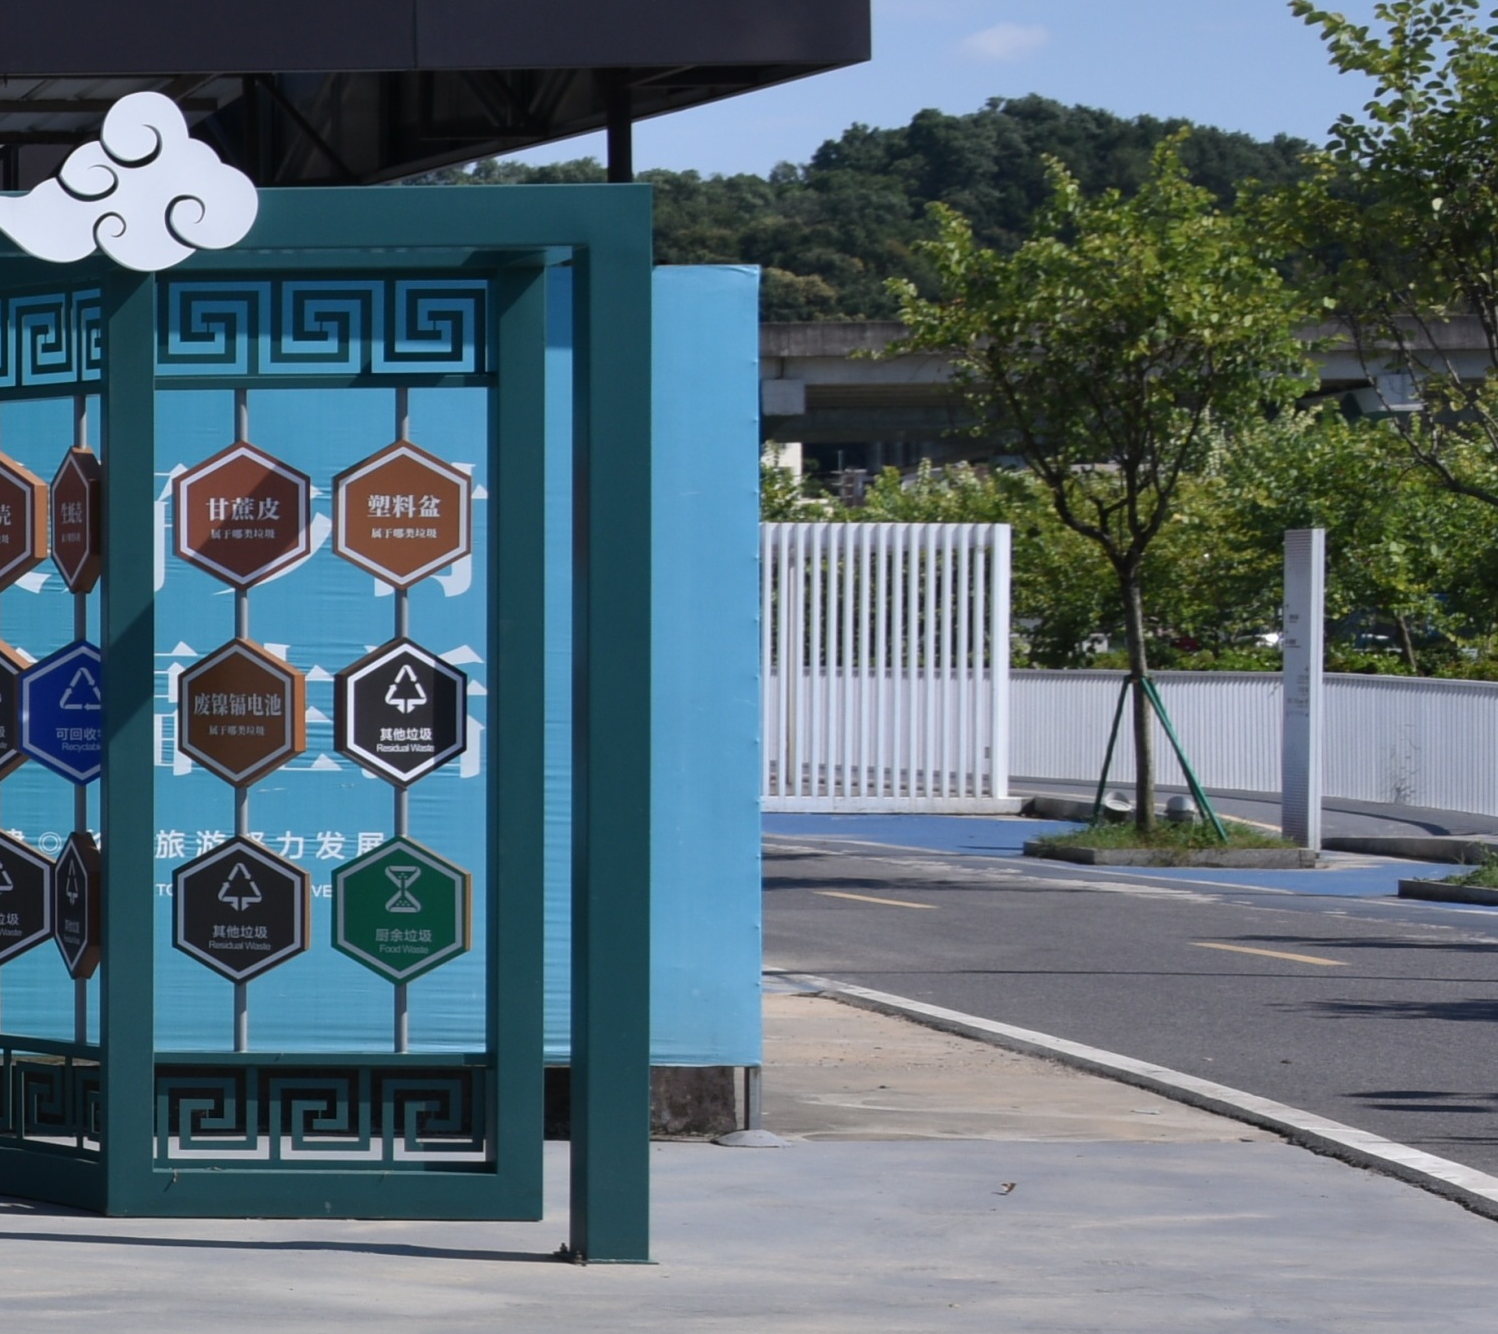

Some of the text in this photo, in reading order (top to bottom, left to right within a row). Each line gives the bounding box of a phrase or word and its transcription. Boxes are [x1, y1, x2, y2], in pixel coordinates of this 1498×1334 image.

[205, 498, 280, 522] 甘蔗皮
[367, 495, 441, 519] 塑料盆
[194, 693, 282, 717] 废镍镉电池
[379, 728, 432, 742] 其他垃圾
[212, 924, 268, 939] 其他垃圾
[375, 928, 432, 943] 厨余垃圾
